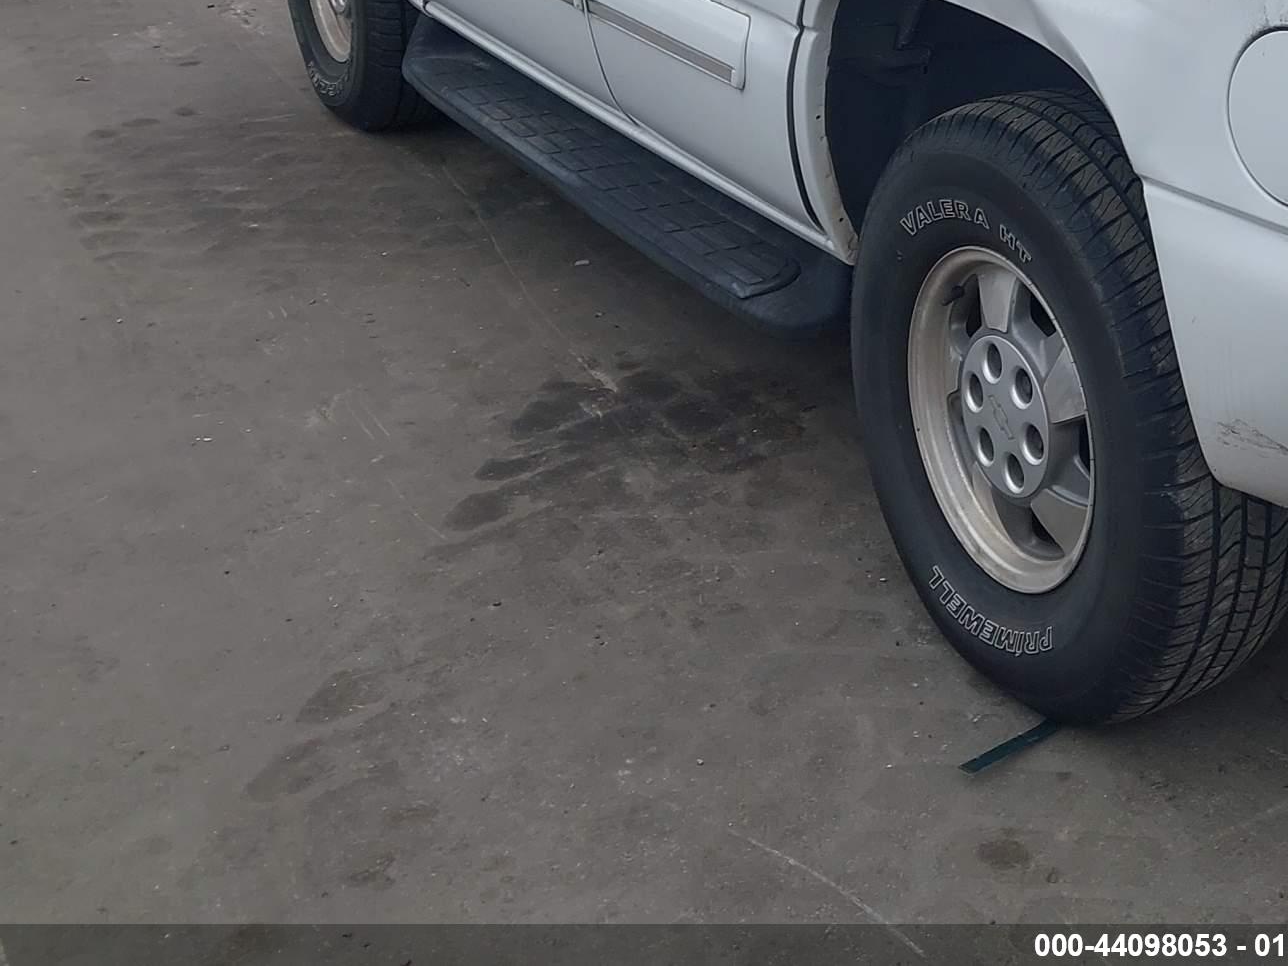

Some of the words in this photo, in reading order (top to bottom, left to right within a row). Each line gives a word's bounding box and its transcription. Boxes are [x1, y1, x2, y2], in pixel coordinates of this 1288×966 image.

[899, 199, 990, 236] VALERA
[999, 223, 1033, 263] HT
[928, 564, 1054, 657] PRIMEWELL
